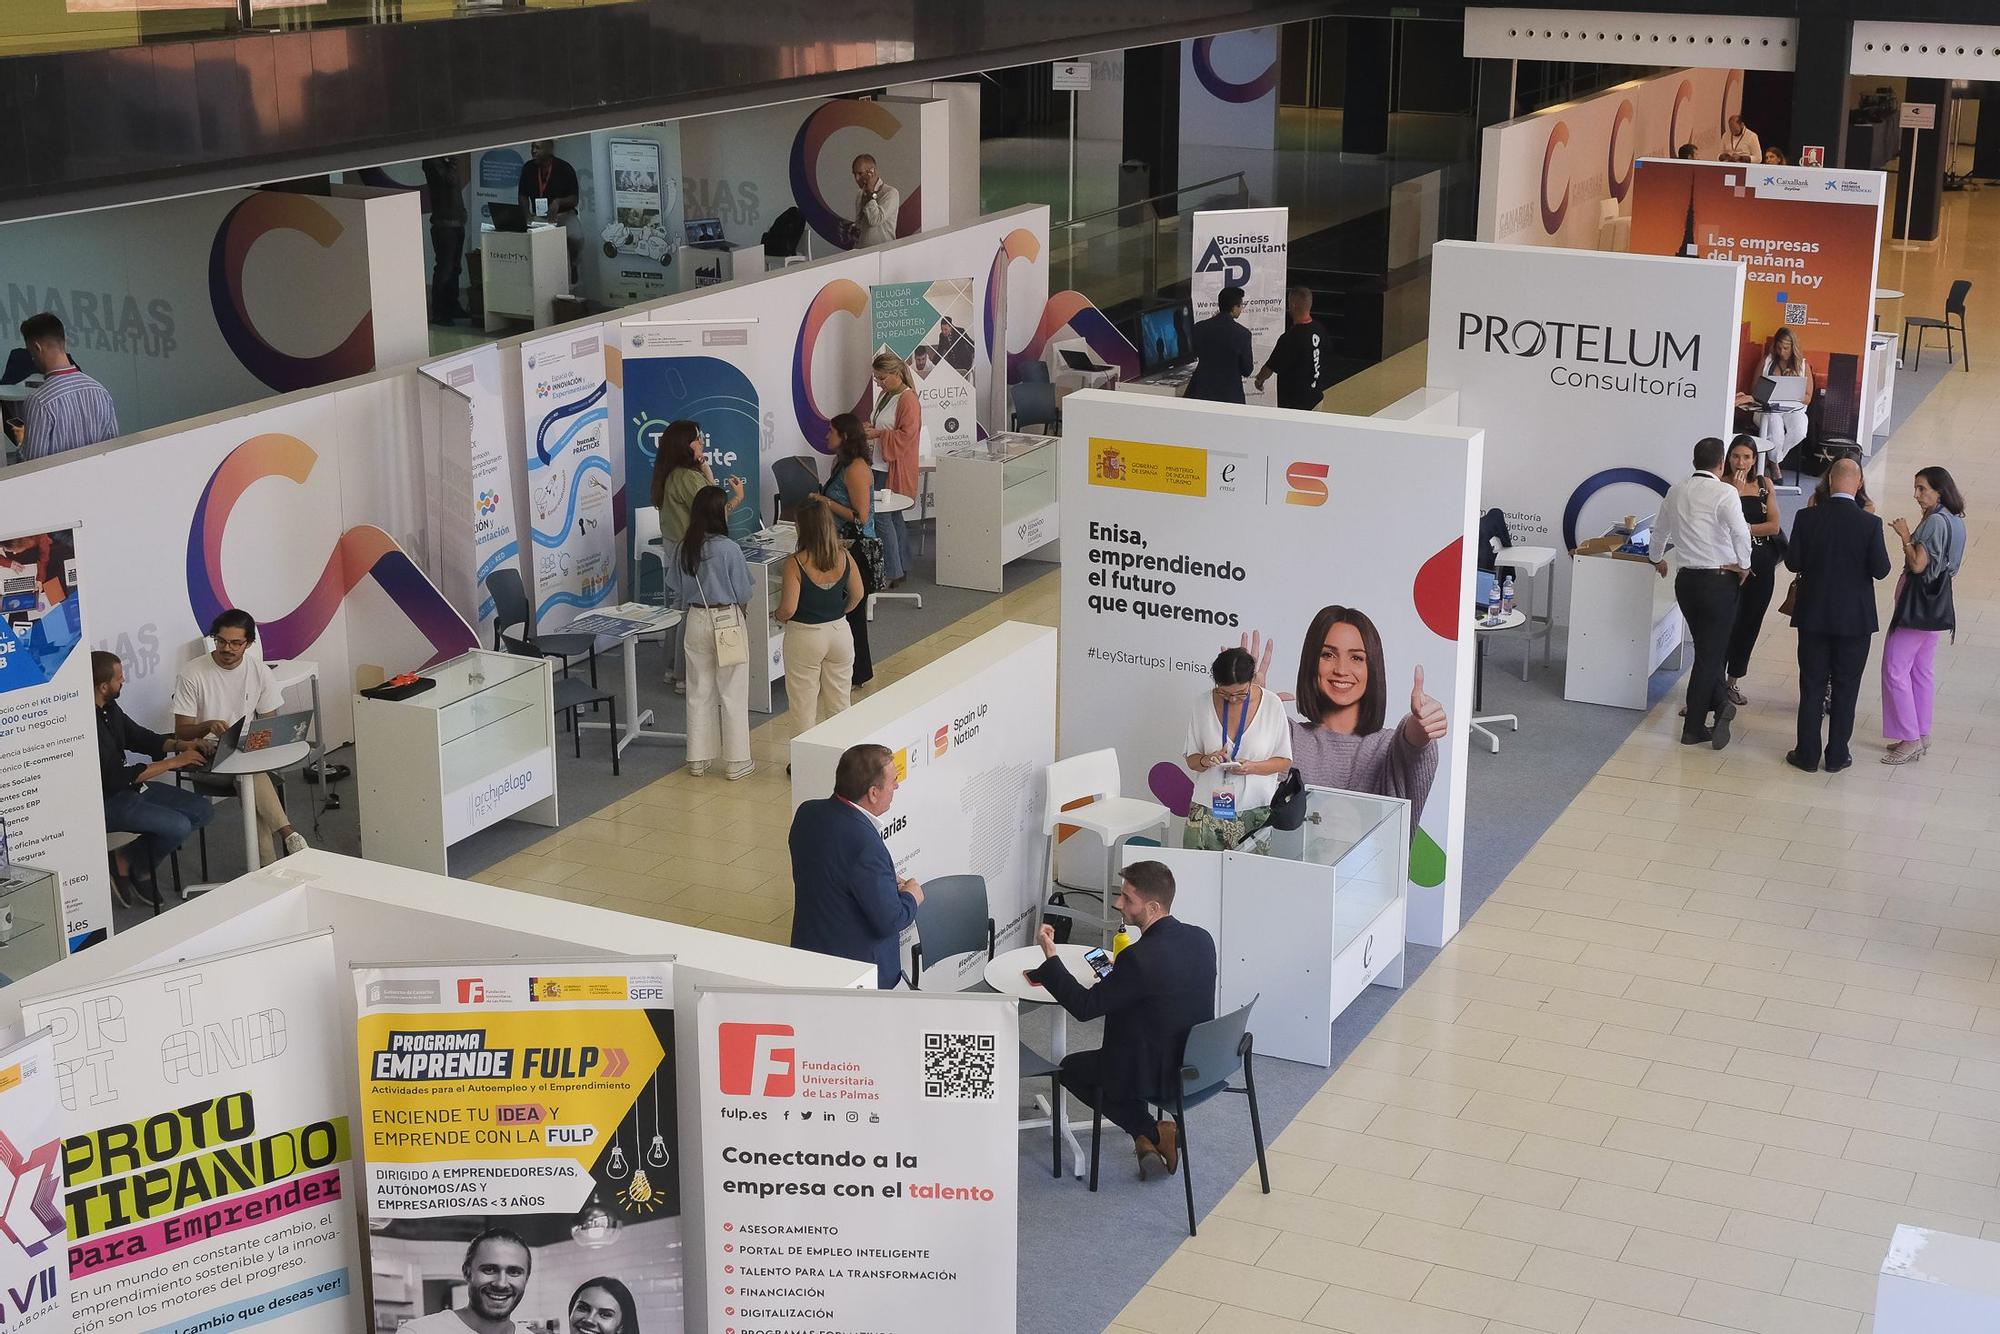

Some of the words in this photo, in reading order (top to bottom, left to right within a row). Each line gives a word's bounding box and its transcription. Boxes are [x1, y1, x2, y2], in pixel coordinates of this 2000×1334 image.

[1777, 177, 1808, 186] CaixaBank
[1217, 234, 1269, 244] Business
[1708, 234, 1734, 247] Las
[1740, 238, 1819, 253] empresas
[1222, 243, 1286, 255] Consultant
[1707, 249, 1732, 261] del
[1739, 253, 1804, 268] mañana
[1791, 271, 1823, 288] hoy
[876, 290, 884, 298] EL
[886, 288, 911, 297] LUGAR
[876, 300, 904, 309] DONDE
[906, 298, 920, 306] TUS
[1250, 298, 1282, 307] company
[876, 310, 898, 319] IDEAS
[899, 309, 908, 317] SE
[876, 319, 925, 329] CONVIERTEN
[876, 330, 888, 339] EN
[889, 328, 925, 337] REALIDAD
[1457, 312, 1701, 372] PROTELUM
[1550, 366, 1698, 400] Consultoría
[1131, 462, 1158, 470] GOBIERNO
[1090, 521, 1147, 549] Enisa,
[1536, 525, 1548, 534] de
[1088, 547, 1246, 582] emprendiendo
[1088, 570, 1107, 587] el
[1112, 571, 1176, 596] futuro
[1088, 593, 1128, 616] que
[1132, 599, 1239, 628] queremos
[1087, 647, 1166, 669] #LeyStartups
[16, 703, 30, 711] con
[54, 690, 79, 702] Digital
[22, 709, 48, 720] euros
[954, 710, 975, 731] Spain
[977, 703, 988, 717] Up
[16, 723, 26, 732] tu
[28, 715, 67, 730] negocio!
[22, 743, 45, 753] básica
[57, 734, 85, 745] internet
[953, 724, 979, 747] Nation
[24, 750, 73, 769] (E-commerce)
[11, 773, 41, 786] Sociales
[22, 788, 38, 797] CRM
[26, 800, 41, 809] ERP
[14, 838, 40, 850] oficina
[41, 831, 65, 842] virtual
[17, 850, 45, 863] seguras
[69, 873, 89, 886] (SEO)
[630, 988, 663, 1000] SEPE
[393, 1034, 480, 1051] PROGRAMA
[377, 1052, 508, 1078] EMPRENDE
[522, 1046, 599, 1078] FULP
[802, 1061, 860, 1072] Fundación
[372, 1085, 429, 1095] Actividades
[432, 1086, 454, 1095] para
[456, 1085, 465, 1093] el
[468, 1084, 527, 1094] Autoempleo
[530, 1085, 536, 1093] y
[539, 1084, 547, 1092] el
[550, 1082, 630, 1093] Emprendimiento
[802, 1075, 874, 1086] Universitaria
[803, 1089, 816, 1098] de
[819, 1090, 837, 1099] Las
[840, 1090, 880, 1100] Palmas
[372, 1108, 461, 1124] ENCIENDE
[467, 1108, 488, 1121] TU
[498, 1108, 540, 1121] IDEA
[549, 1107, 560, 1120] Y
[720, 1108, 768, 1121] fulp.es
[62, 1091, 256, 1188] PROTO
[374, 1130, 470, 1146] EMPRENDE
[475, 1130, 511, 1143] CON
[517, 1130, 540, 1142] LA
[549, 1128, 594, 1142] FULP
[722, 1147, 866, 1168] Conectando
[873, 1156, 888, 1168] a
[896, 1152, 918, 1168] la
[65, 1120, 337, 1240] TIPANDO
[376, 1170, 428, 1180] DIRIGIDO
[432, 1170, 440, 1179] A
[443, 1166, 578, 1179] EMPRENDEDORES/AS,
[377, 1182, 476, 1195] AUTÓNOMOS/AS
[480, 1183, 487, 1192] Y
[723, 1180, 826, 1198] empresa
[833, 1183, 874, 1198] con
[882, 1182, 901, 1198] el
[909, 1183, 994, 1202] talento
[378, 1198, 488, 1210] EMPRESARIOS/AS
[510, 1195, 545, 1207] AÑOS
[69, 1233, 147, 1273] Para
[164, 1174, 340, 1245] Emprender
[739, 1225, 839, 1236] ASESORAMIENTO
[71, 1291, 89, 1303] En
[93, 1284, 112, 1295] un
[116, 1267, 168, 1287] mundo
[172, 1261, 189, 1274] en
[193, 1240, 260, 1266] constante
[263, 1221, 317, 1245] cambio,
[320, 1214, 333, 1226] el
[739, 1245, 784, 1255] PORTAL
[788, 1247, 802, 1255] DE
[807, 1247, 852, 1257] EMPLEO
[857, 1248, 930, 1259] INTELIGENTE
[72, 1275, 192, 1320] emprendimiento
[195, 1252, 264, 1280] sostenible
[267, 1251, 275, 1262] y
[277, 1244, 289, 1256] la
[293, 1230, 341, 1251] innova-
[740, 1266, 791, 1277] TALENTO
[795, 1268, 824, 1277] PARA
[829, 1269, 843, 1278] LA
[847, 1269, 957, 1280] TRANSFORMACIÓN
[8, 1266, 56, 1314] VII
[74, 1319, 104, 1334] ción
[108, 1311, 133, 1326] son
[137, 1303, 157, 1318] los
[161, 1283, 217, 1311] motores
[220, 1277, 243, 1294] del
[246, 1257, 307, 1284] progreso.
[740, 1287, 825, 1298] FINANCIACIÓN
[238, 1304, 266, 1324] que
[268, 1288, 314, 1311] deseas
[316, 1277, 341, 1293] ver!
[12, 1302, 60, 1332] LABORAL
[740, 1308, 834, 1319] DIGITALIZACIÓN
